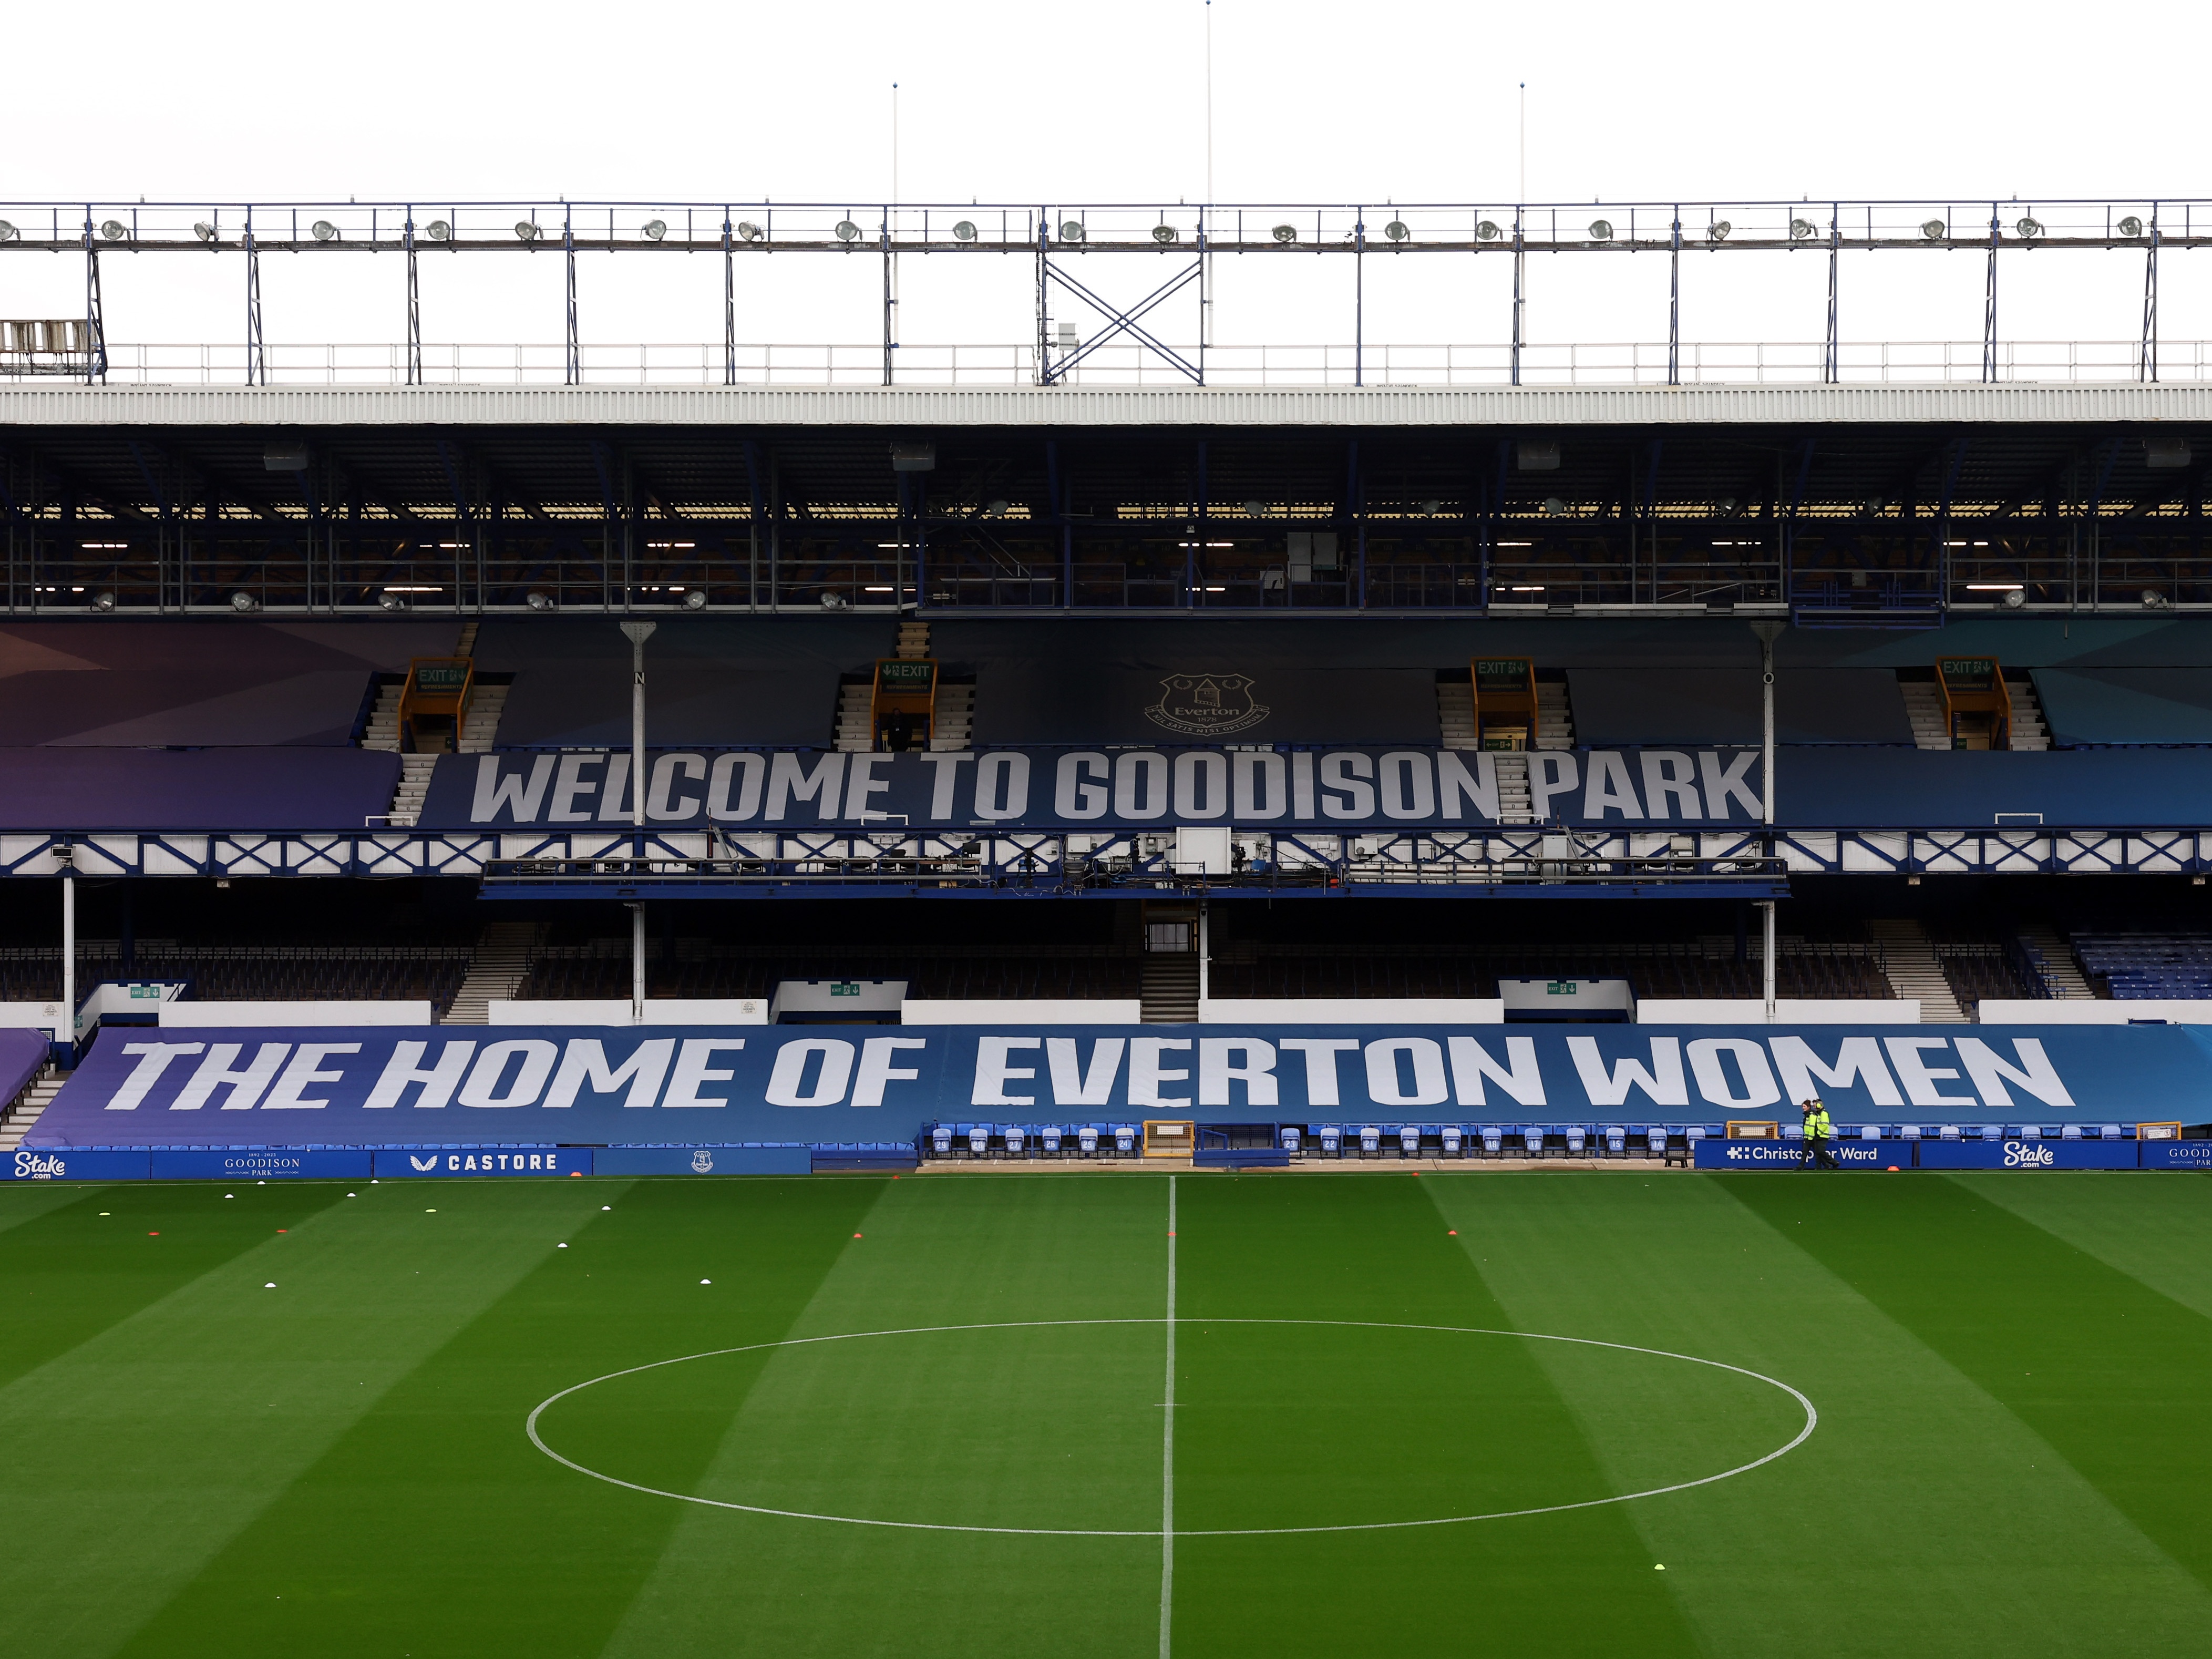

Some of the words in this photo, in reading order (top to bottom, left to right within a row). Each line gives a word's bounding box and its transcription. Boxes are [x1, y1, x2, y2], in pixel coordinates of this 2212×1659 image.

[901, 665, 929, 677] EXIT
[1478, 662, 1506, 674] EXIT
[1944, 661, 1971, 673] EXIT
[419, 670, 447, 682] EXIT
[635, 672, 645, 684] N
[1175, 707, 1240, 715] Everton
[1153, 713, 1166, 723] NIL
[1166, 721, 1192, 732] SATIS
[1223, 713, 1262, 731] OPTIMUM
[470, 753, 894, 822] WELCOME
[921, 752, 1030, 820] TO
[1055, 752, 1500, 821] GOODISON
[1527, 751, 1764, 821] PARK
[104, 1042, 362, 1110] THE
[363, 1039, 745, 1108] HOME
[765, 1038, 926, 1107] OF
[971, 1037, 1547, 1107] EVERTON
[1566, 1037, 2076, 1109] WOMEN
[1010, 1141, 1018, 1149] 27
[1083, 1141, 1092, 1149] 25
[1119, 1140, 1128, 1148] 24
[1406, 1140, 1415, 1148] 20
[1449, 1140, 1456, 1149] 19
[1489, 1140, 1497, 1149] 18
[1531, 1140, 1538, 1149] 17
[1753, 1147, 1837, 1163] Christopr
[1839, 1148, 1877, 1160] Ward
[2004, 1141, 2054, 1166] Stake
[15, 1152, 65, 1177] Stake
[225, 1159, 300, 1168] GOODISON
[448, 1154, 556, 1171] CASTORE
